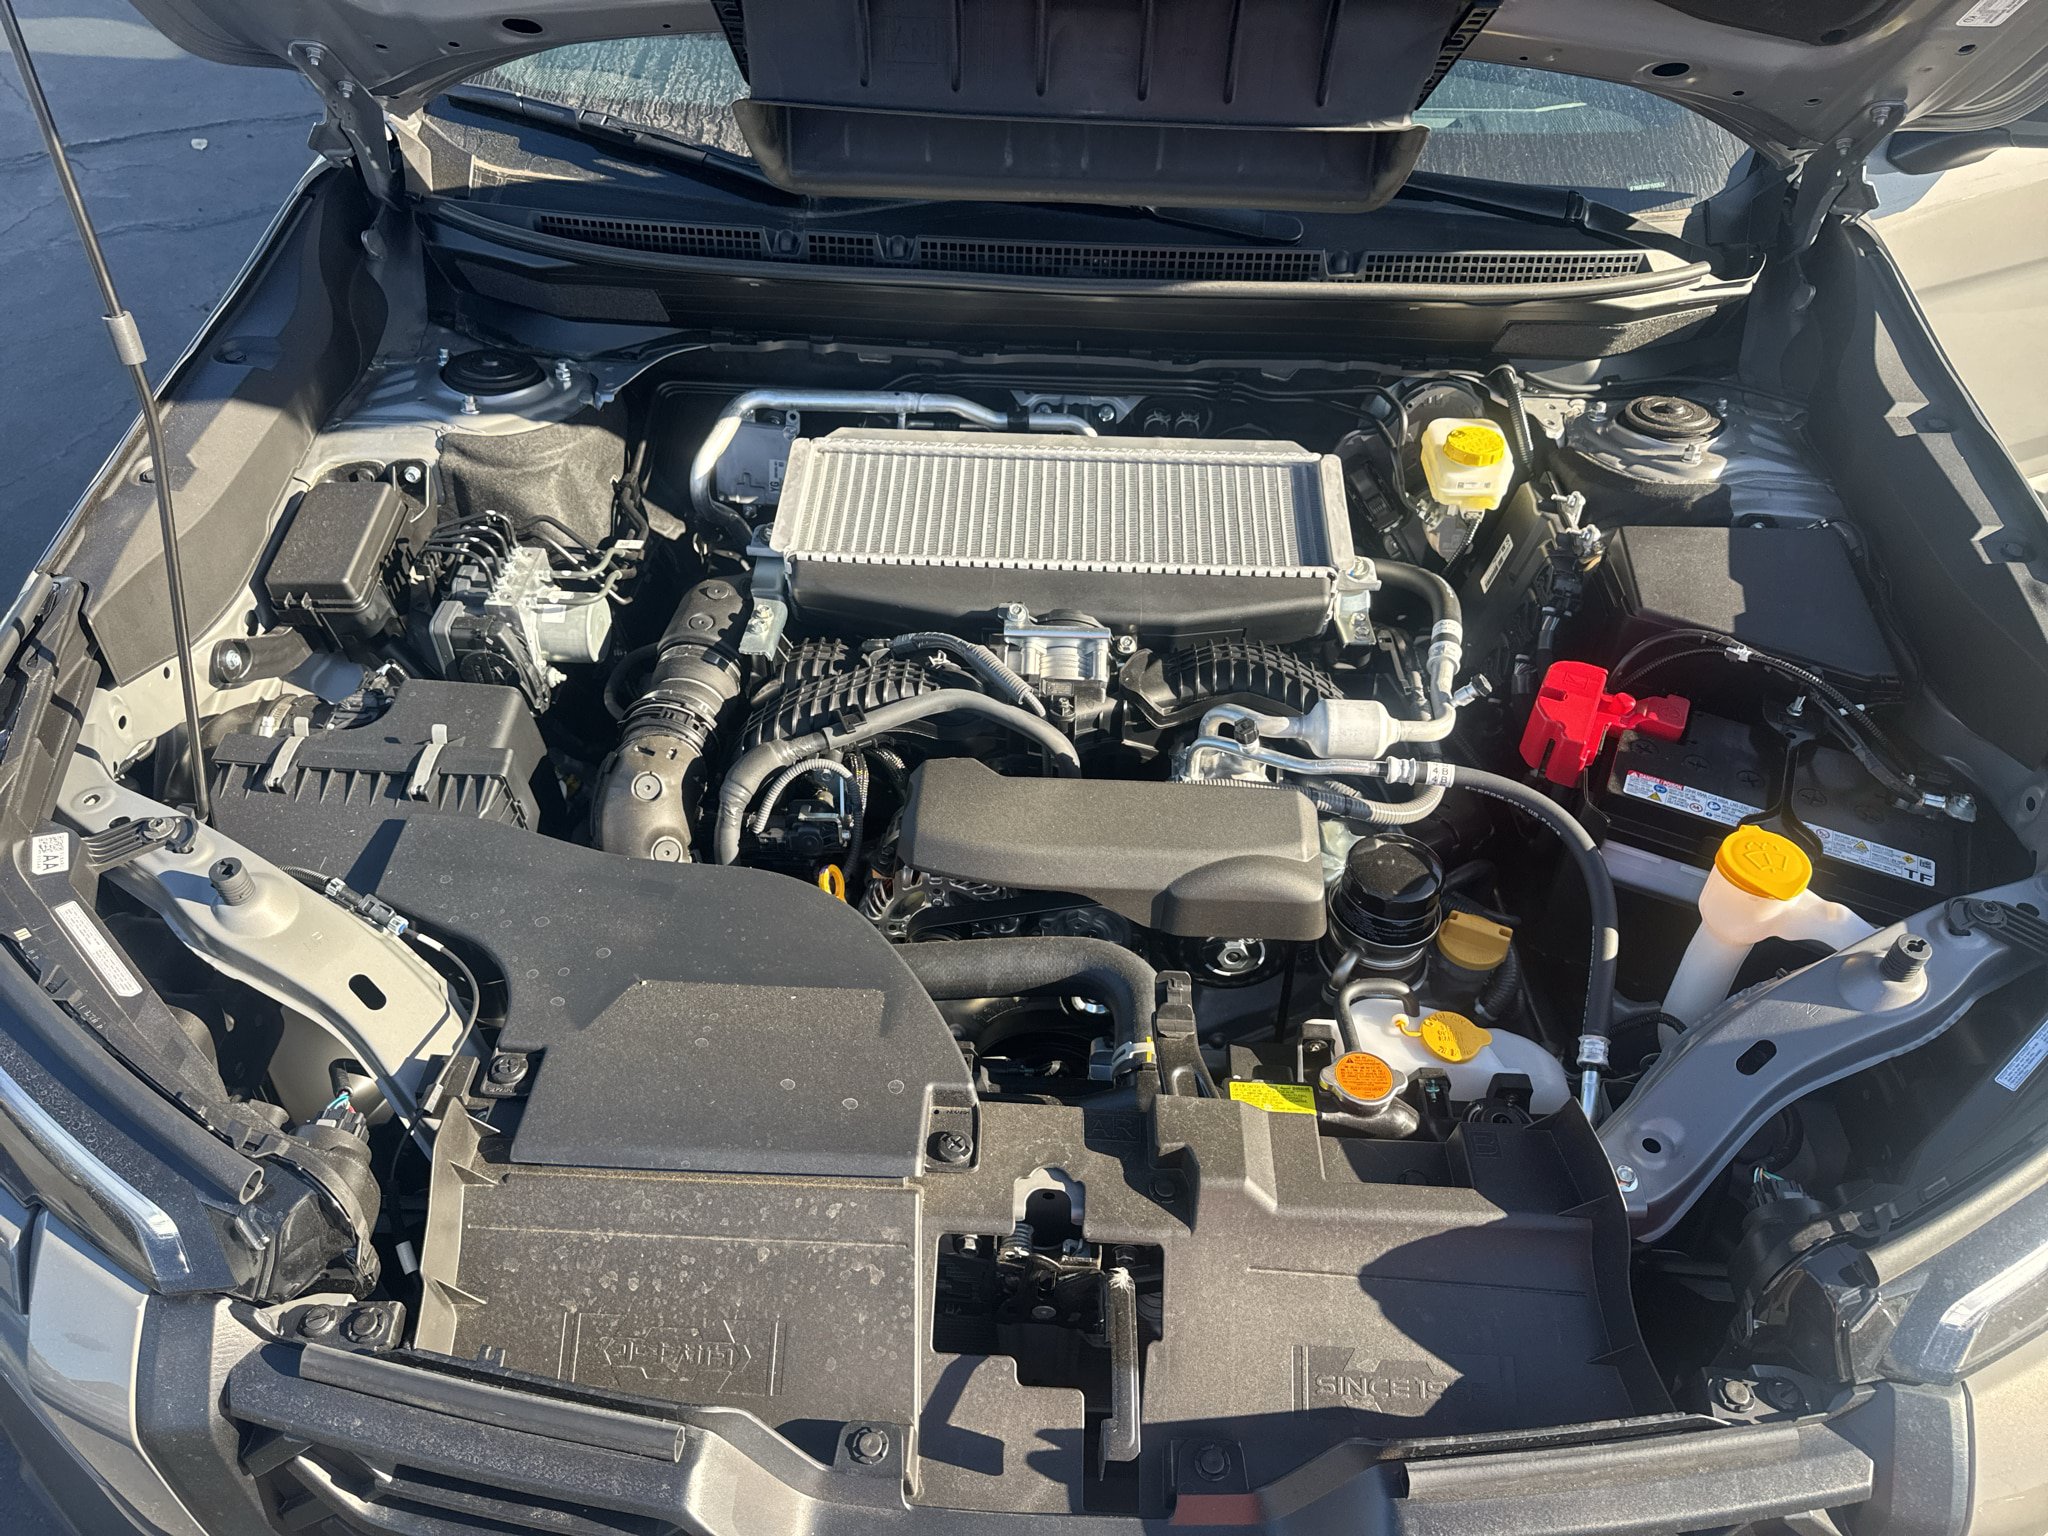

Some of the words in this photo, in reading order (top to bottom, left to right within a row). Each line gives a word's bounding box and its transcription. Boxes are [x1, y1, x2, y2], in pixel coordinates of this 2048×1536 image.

[770, 481, 780, 492] YG
[43, 855, 59, 871] AA
[1904, 867, 1933, 882] TF
[1316, 1376, 1410, 1399] SINCE
